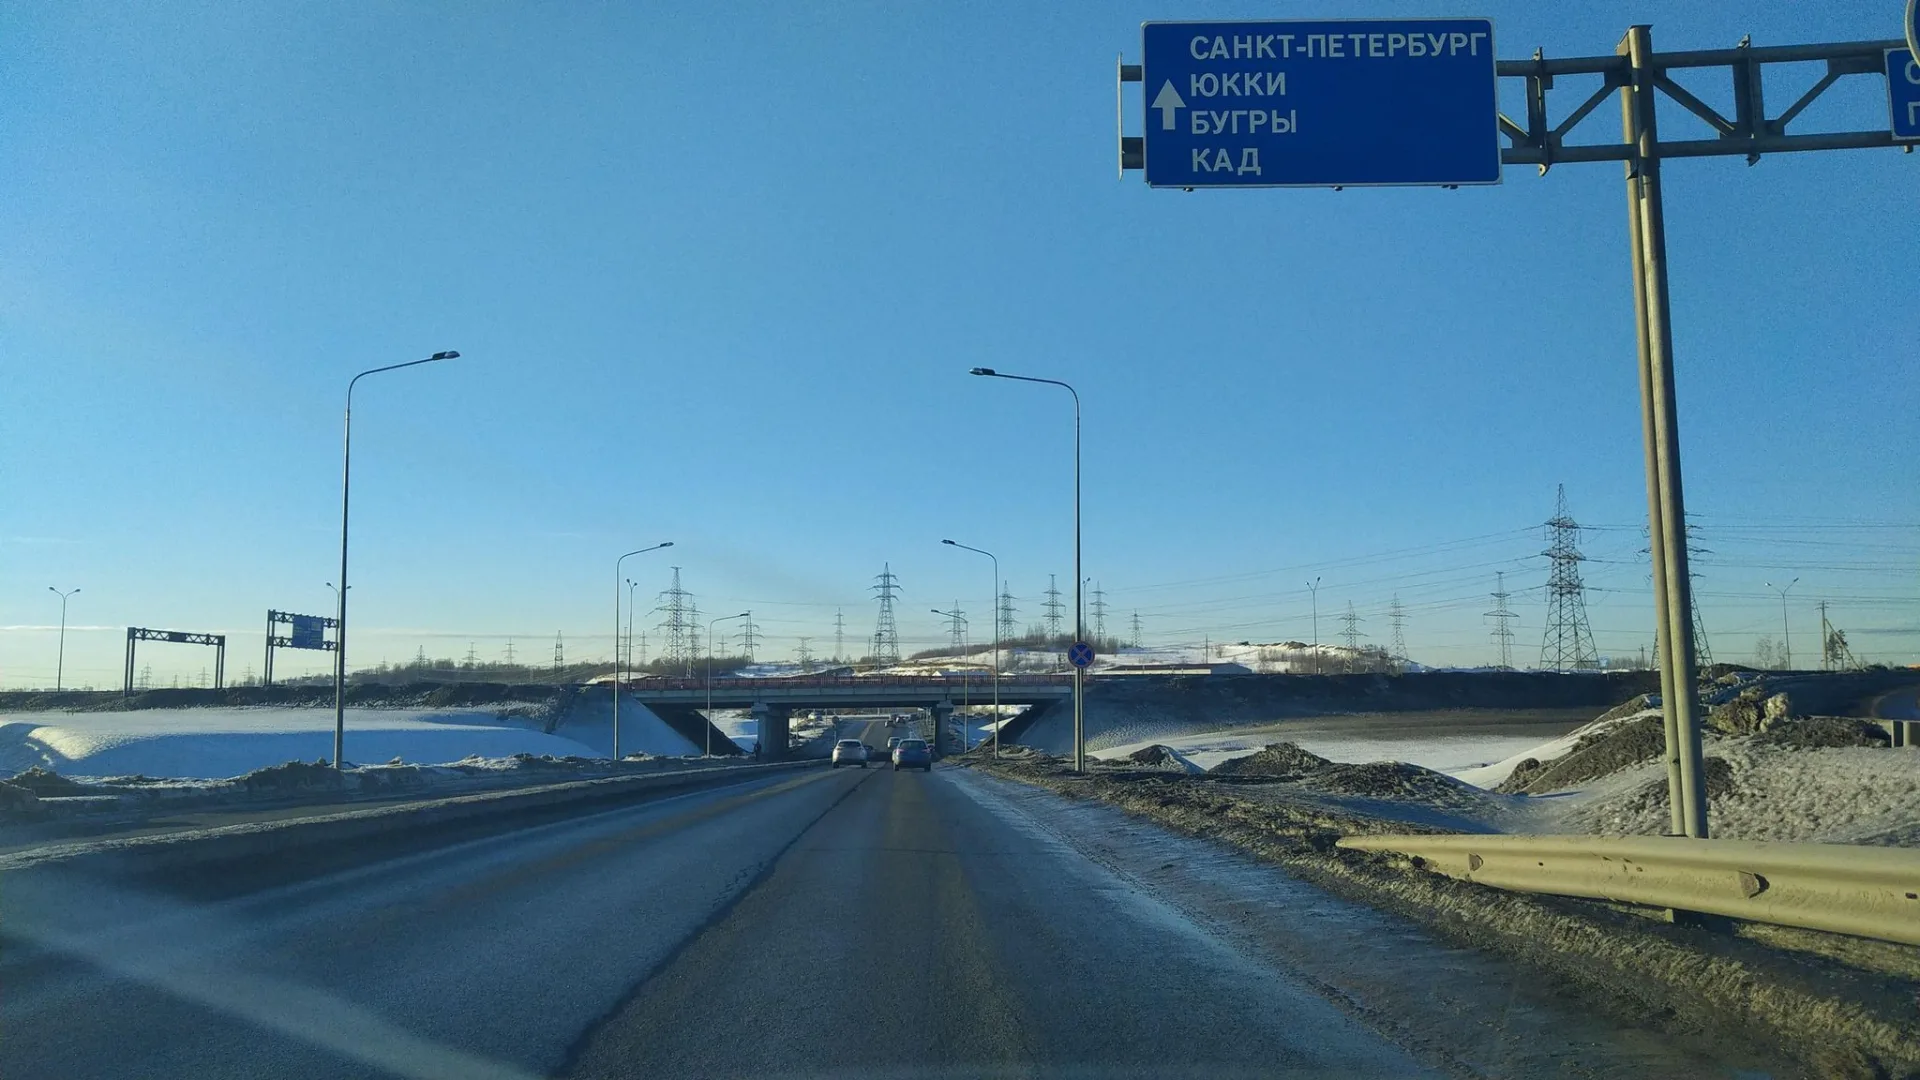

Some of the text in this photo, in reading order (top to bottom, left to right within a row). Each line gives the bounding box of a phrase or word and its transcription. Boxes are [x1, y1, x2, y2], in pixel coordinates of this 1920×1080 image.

[1190, 33, 1487, 60] САНКТ-ПЕТЕРБУРГ
[1190, 72, 1286, 97] ЮККИ
[1191, 109, 1297, 135] БУГРЫ
[1192, 147, 1261, 176] КАД
